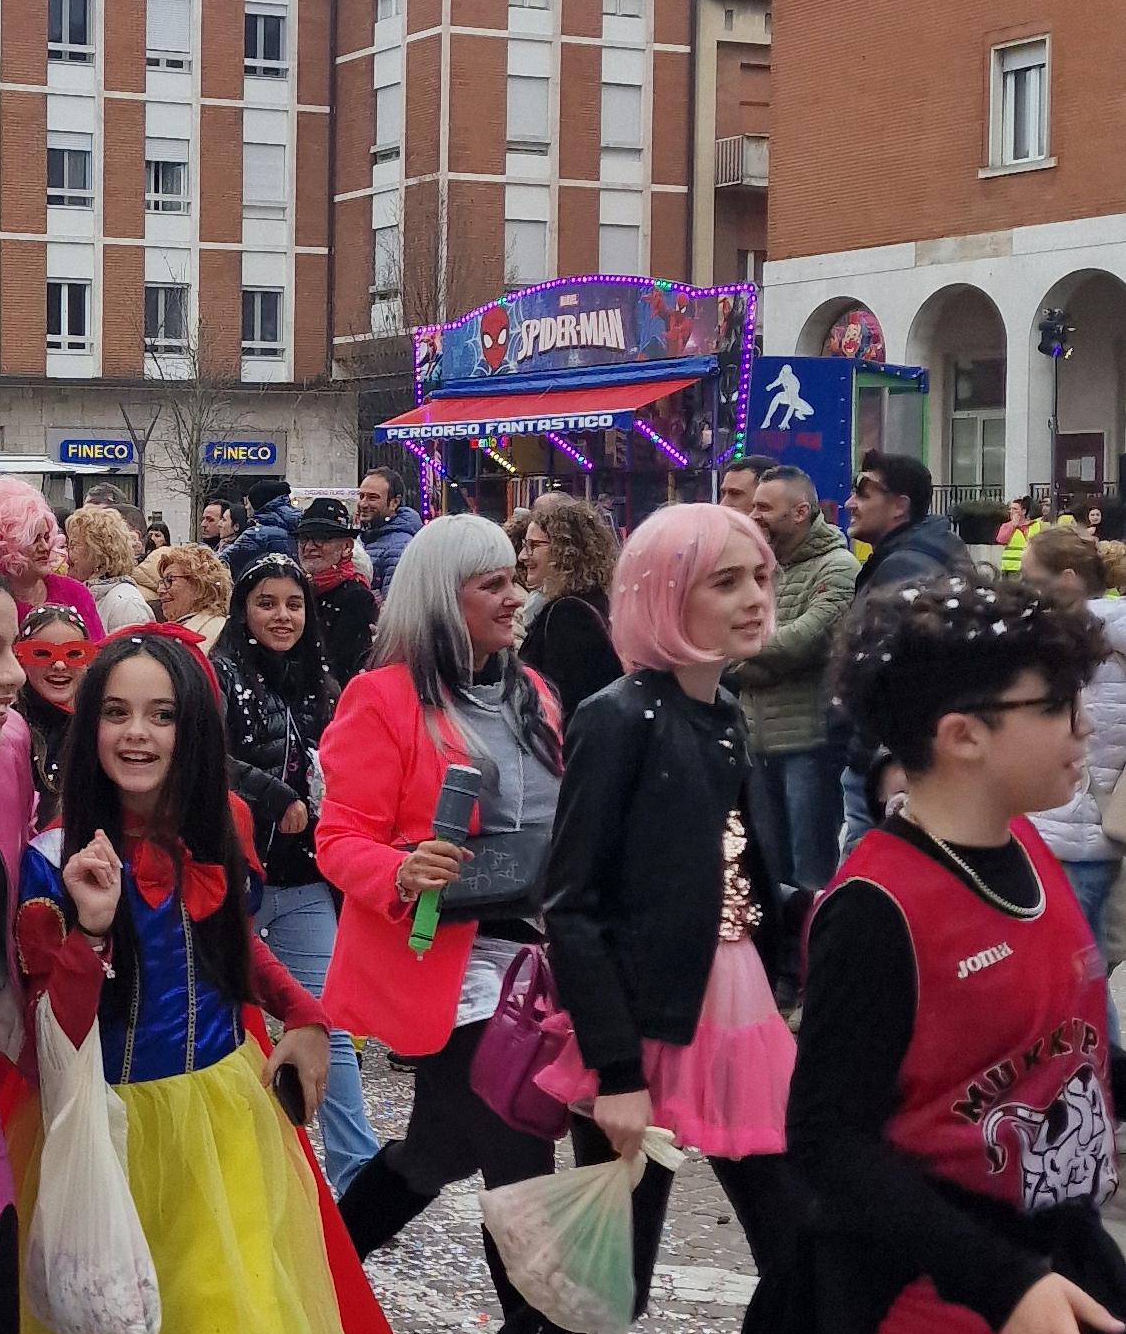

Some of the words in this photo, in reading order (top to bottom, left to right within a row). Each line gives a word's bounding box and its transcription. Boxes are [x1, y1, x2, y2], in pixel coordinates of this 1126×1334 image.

[517, 308, 626, 362] SPIDER-MAN
[386, 423, 480, 440] PERCORSO
[485, 414, 614, 435] FANTASTICO
[67, 443, 129, 460] FINECO
[212, 445, 272, 461] FINECO
